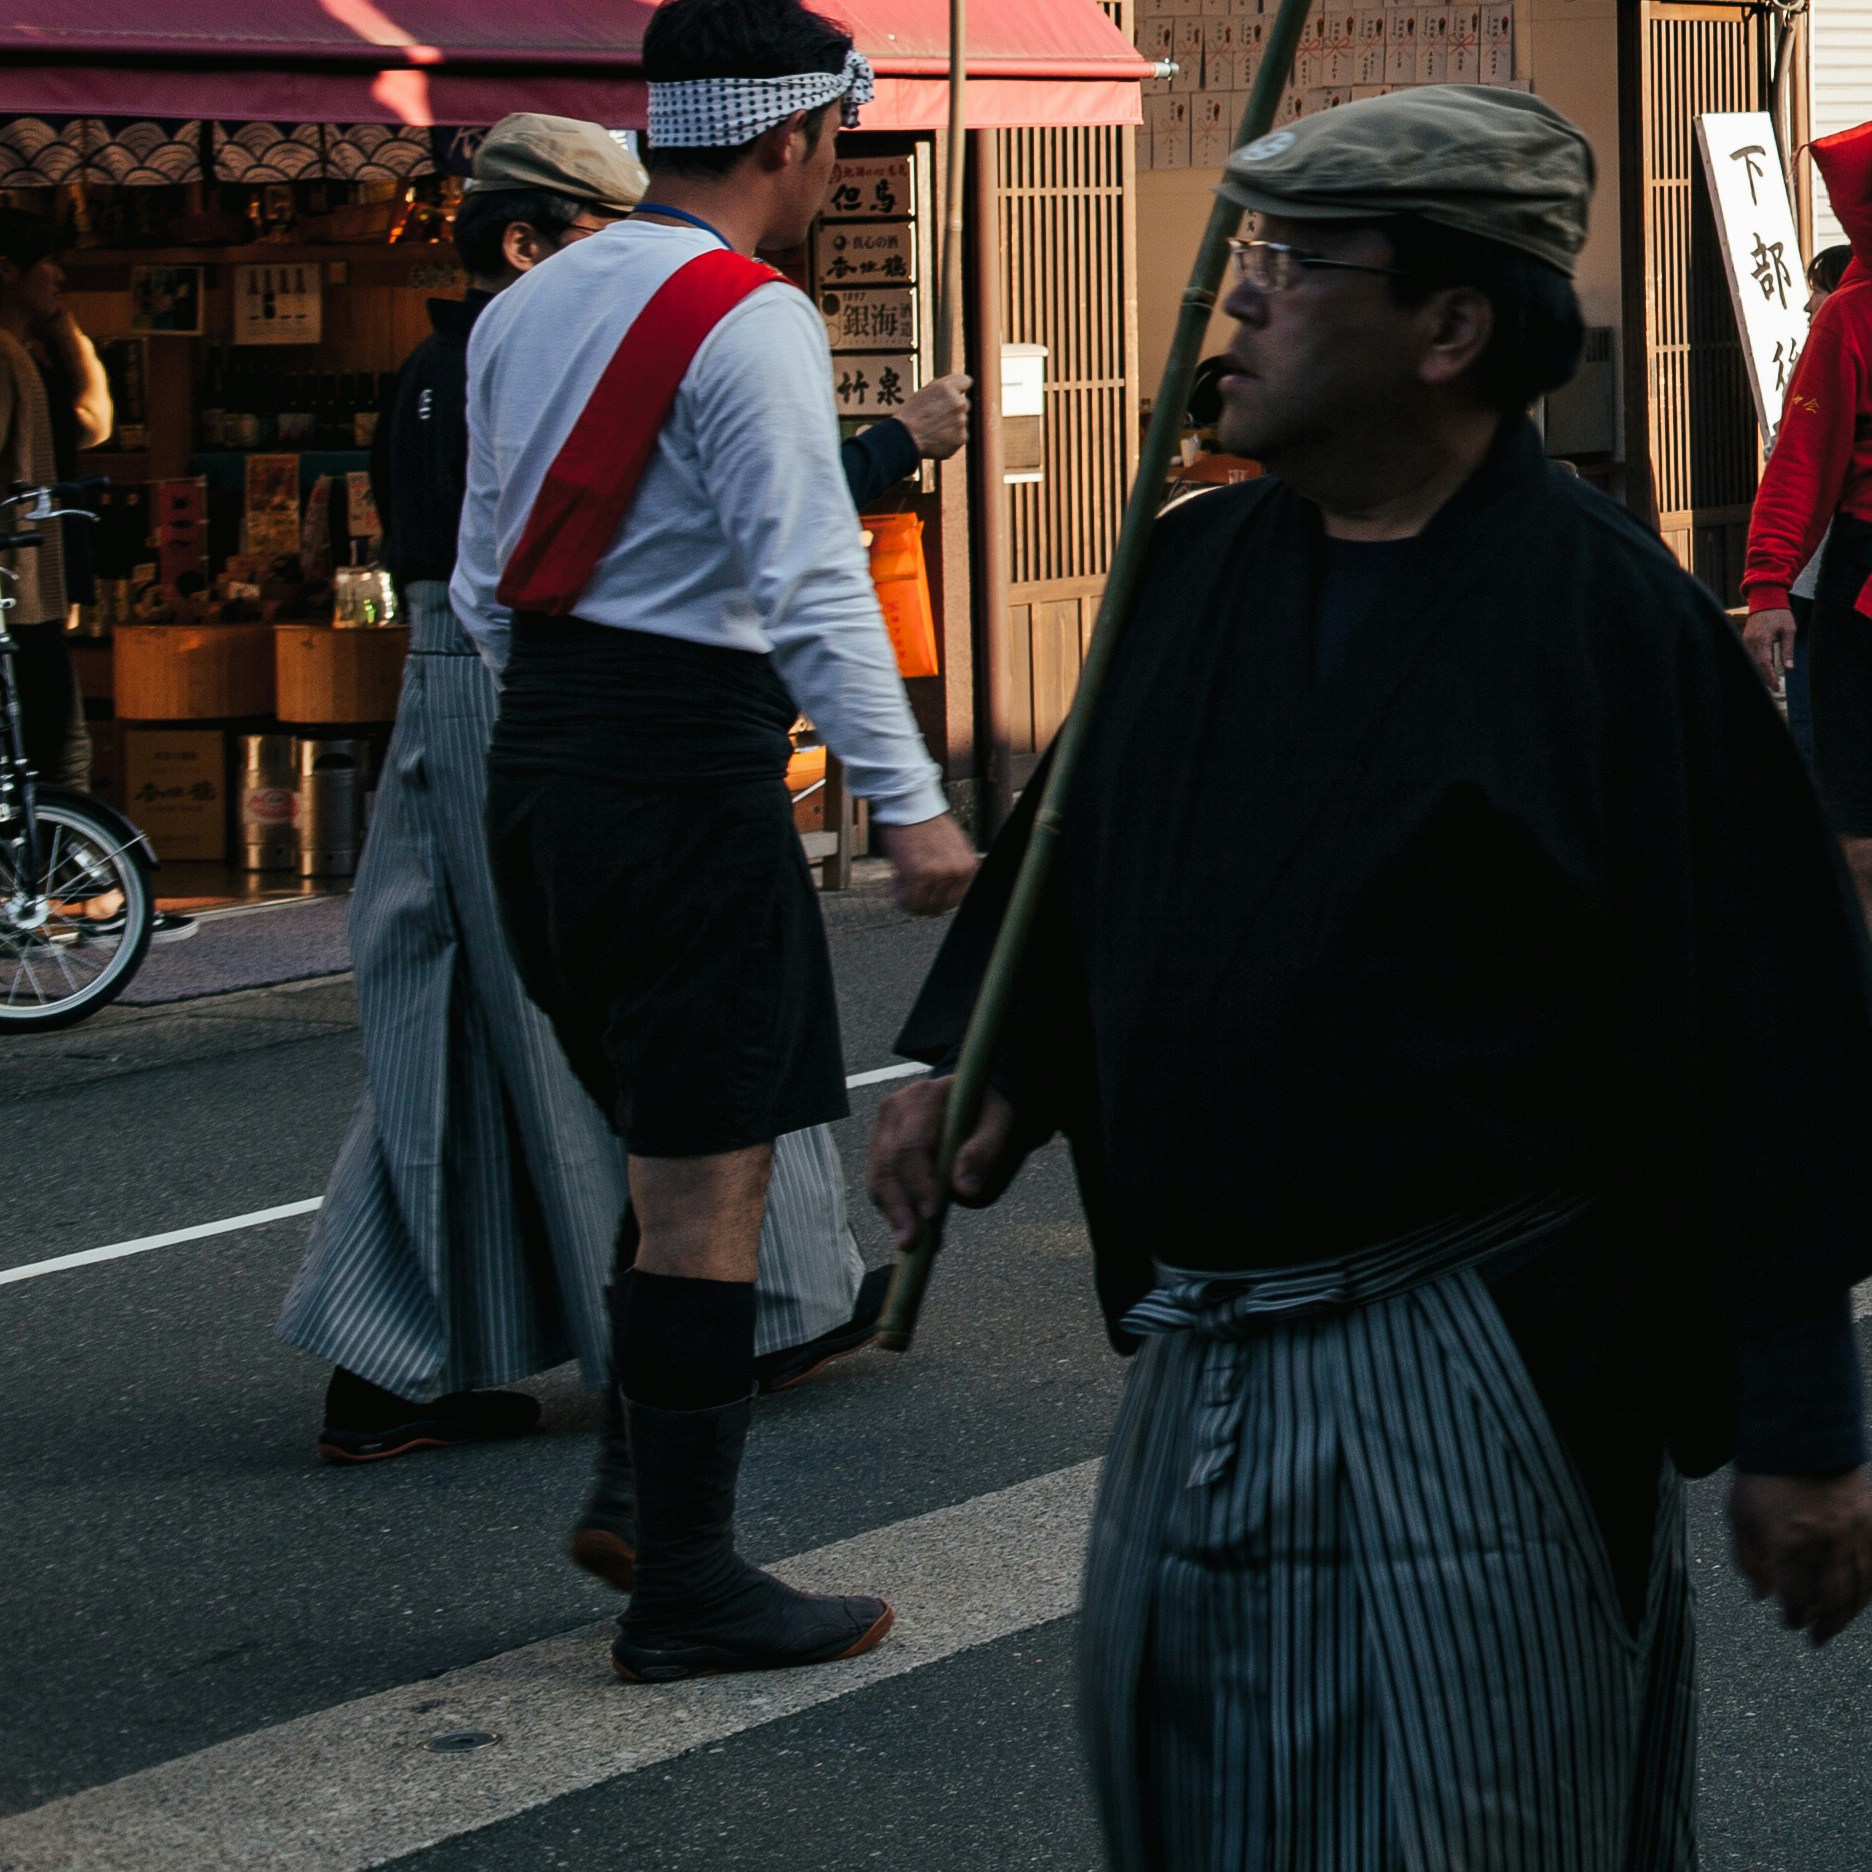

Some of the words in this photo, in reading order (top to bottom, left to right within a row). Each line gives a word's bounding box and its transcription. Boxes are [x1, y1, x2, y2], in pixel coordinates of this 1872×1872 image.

[830, 178, 897, 214] 但馬
[842, 303, 898, 338] 銀海
[837, 366, 905, 406] 竹泉
